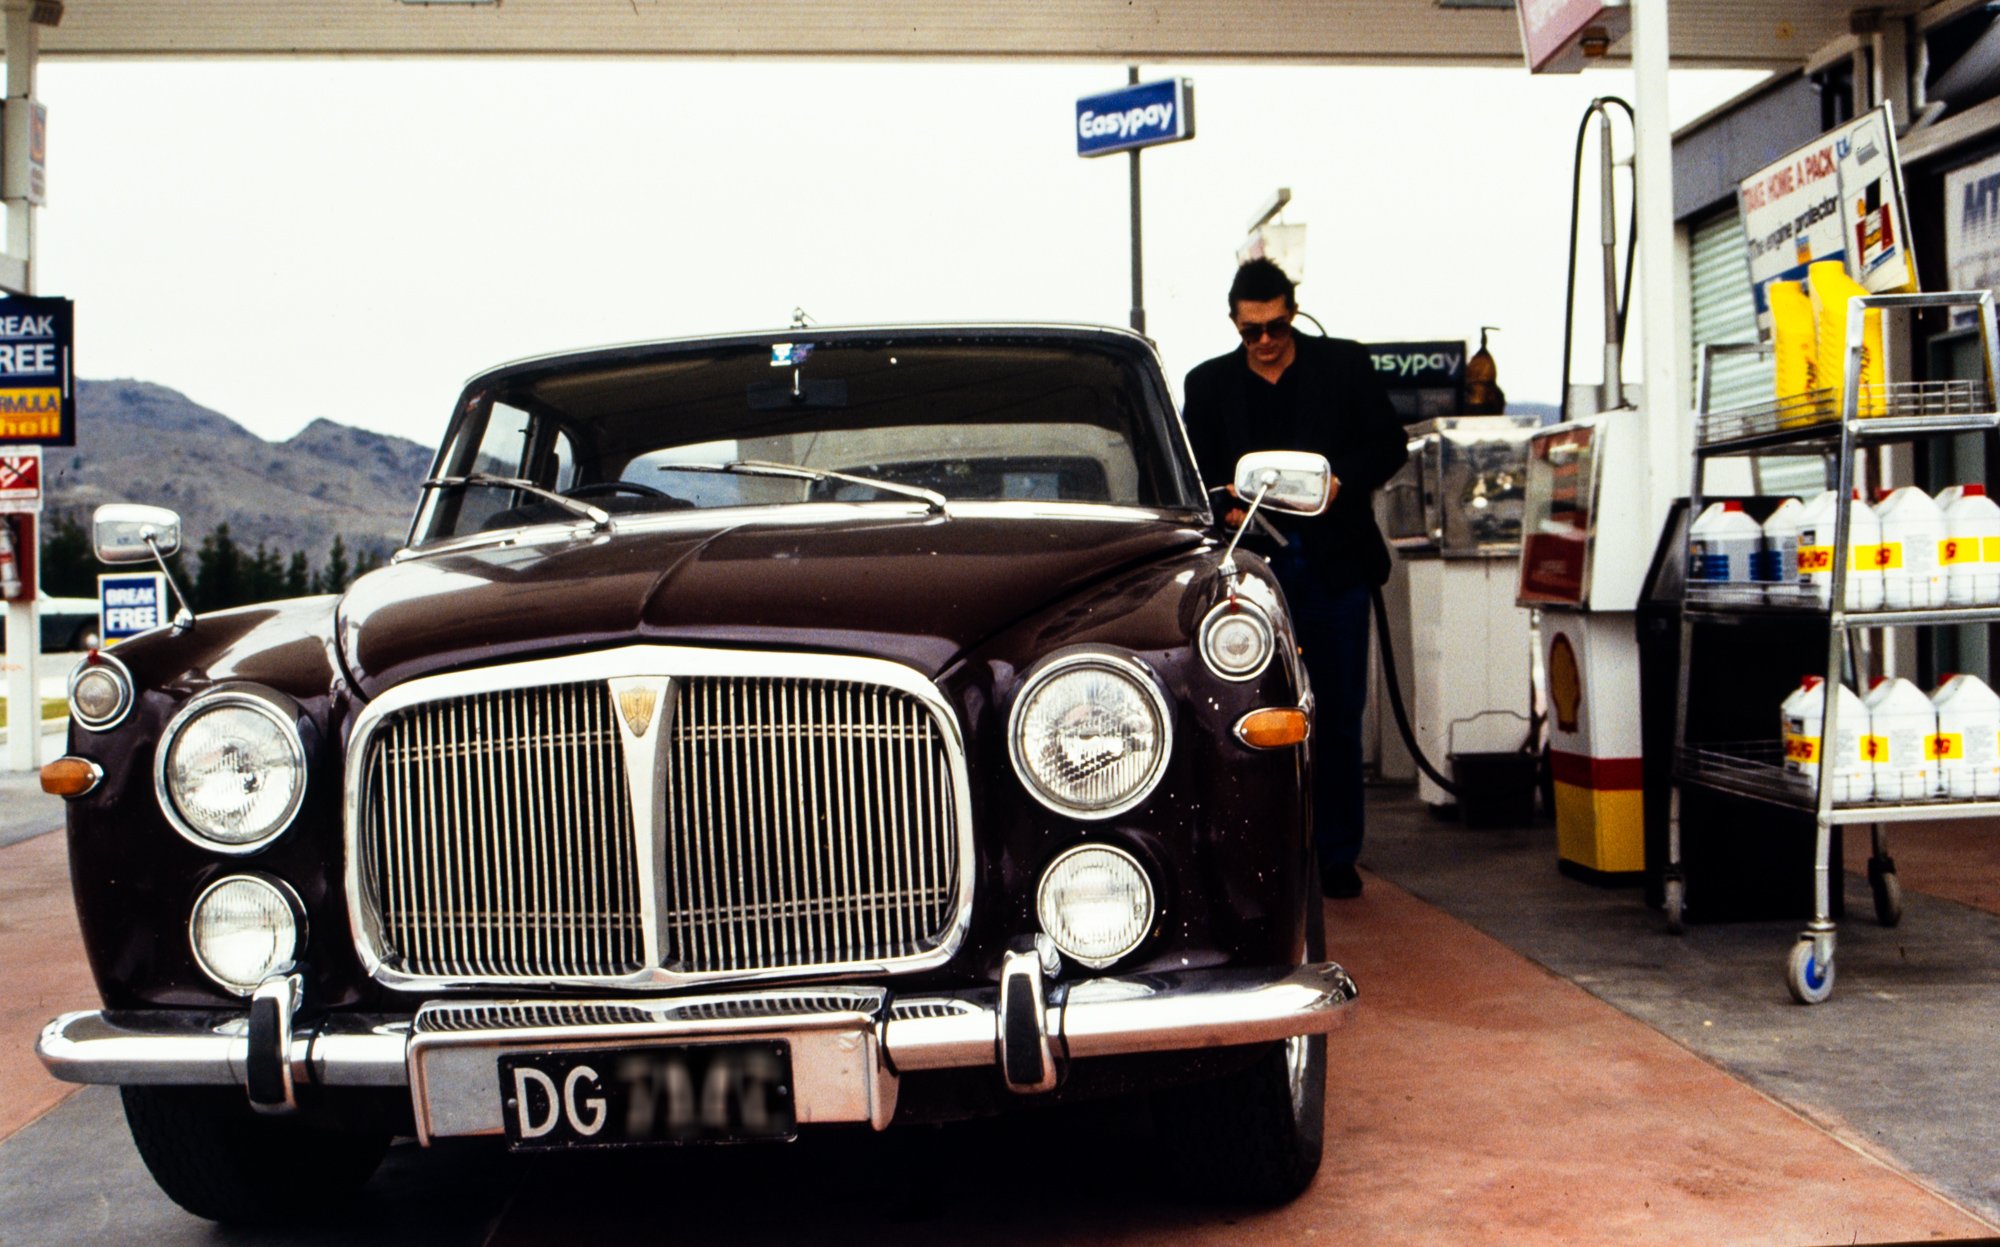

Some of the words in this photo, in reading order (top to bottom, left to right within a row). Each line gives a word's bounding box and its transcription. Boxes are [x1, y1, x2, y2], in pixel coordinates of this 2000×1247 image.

[1079, 101, 1173, 138] Easypay
[1805, 145, 1836, 181] PACK
[0, 315, 54, 336] EAK
[0, 344, 55, 373] REE
[1370, 352, 1461, 376] asypay
[0, 416, 59, 436] hell
[105, 587, 155, 606] BREAK
[105, 607, 156, 632] FREE
[513, 1065, 607, 1138] DG
